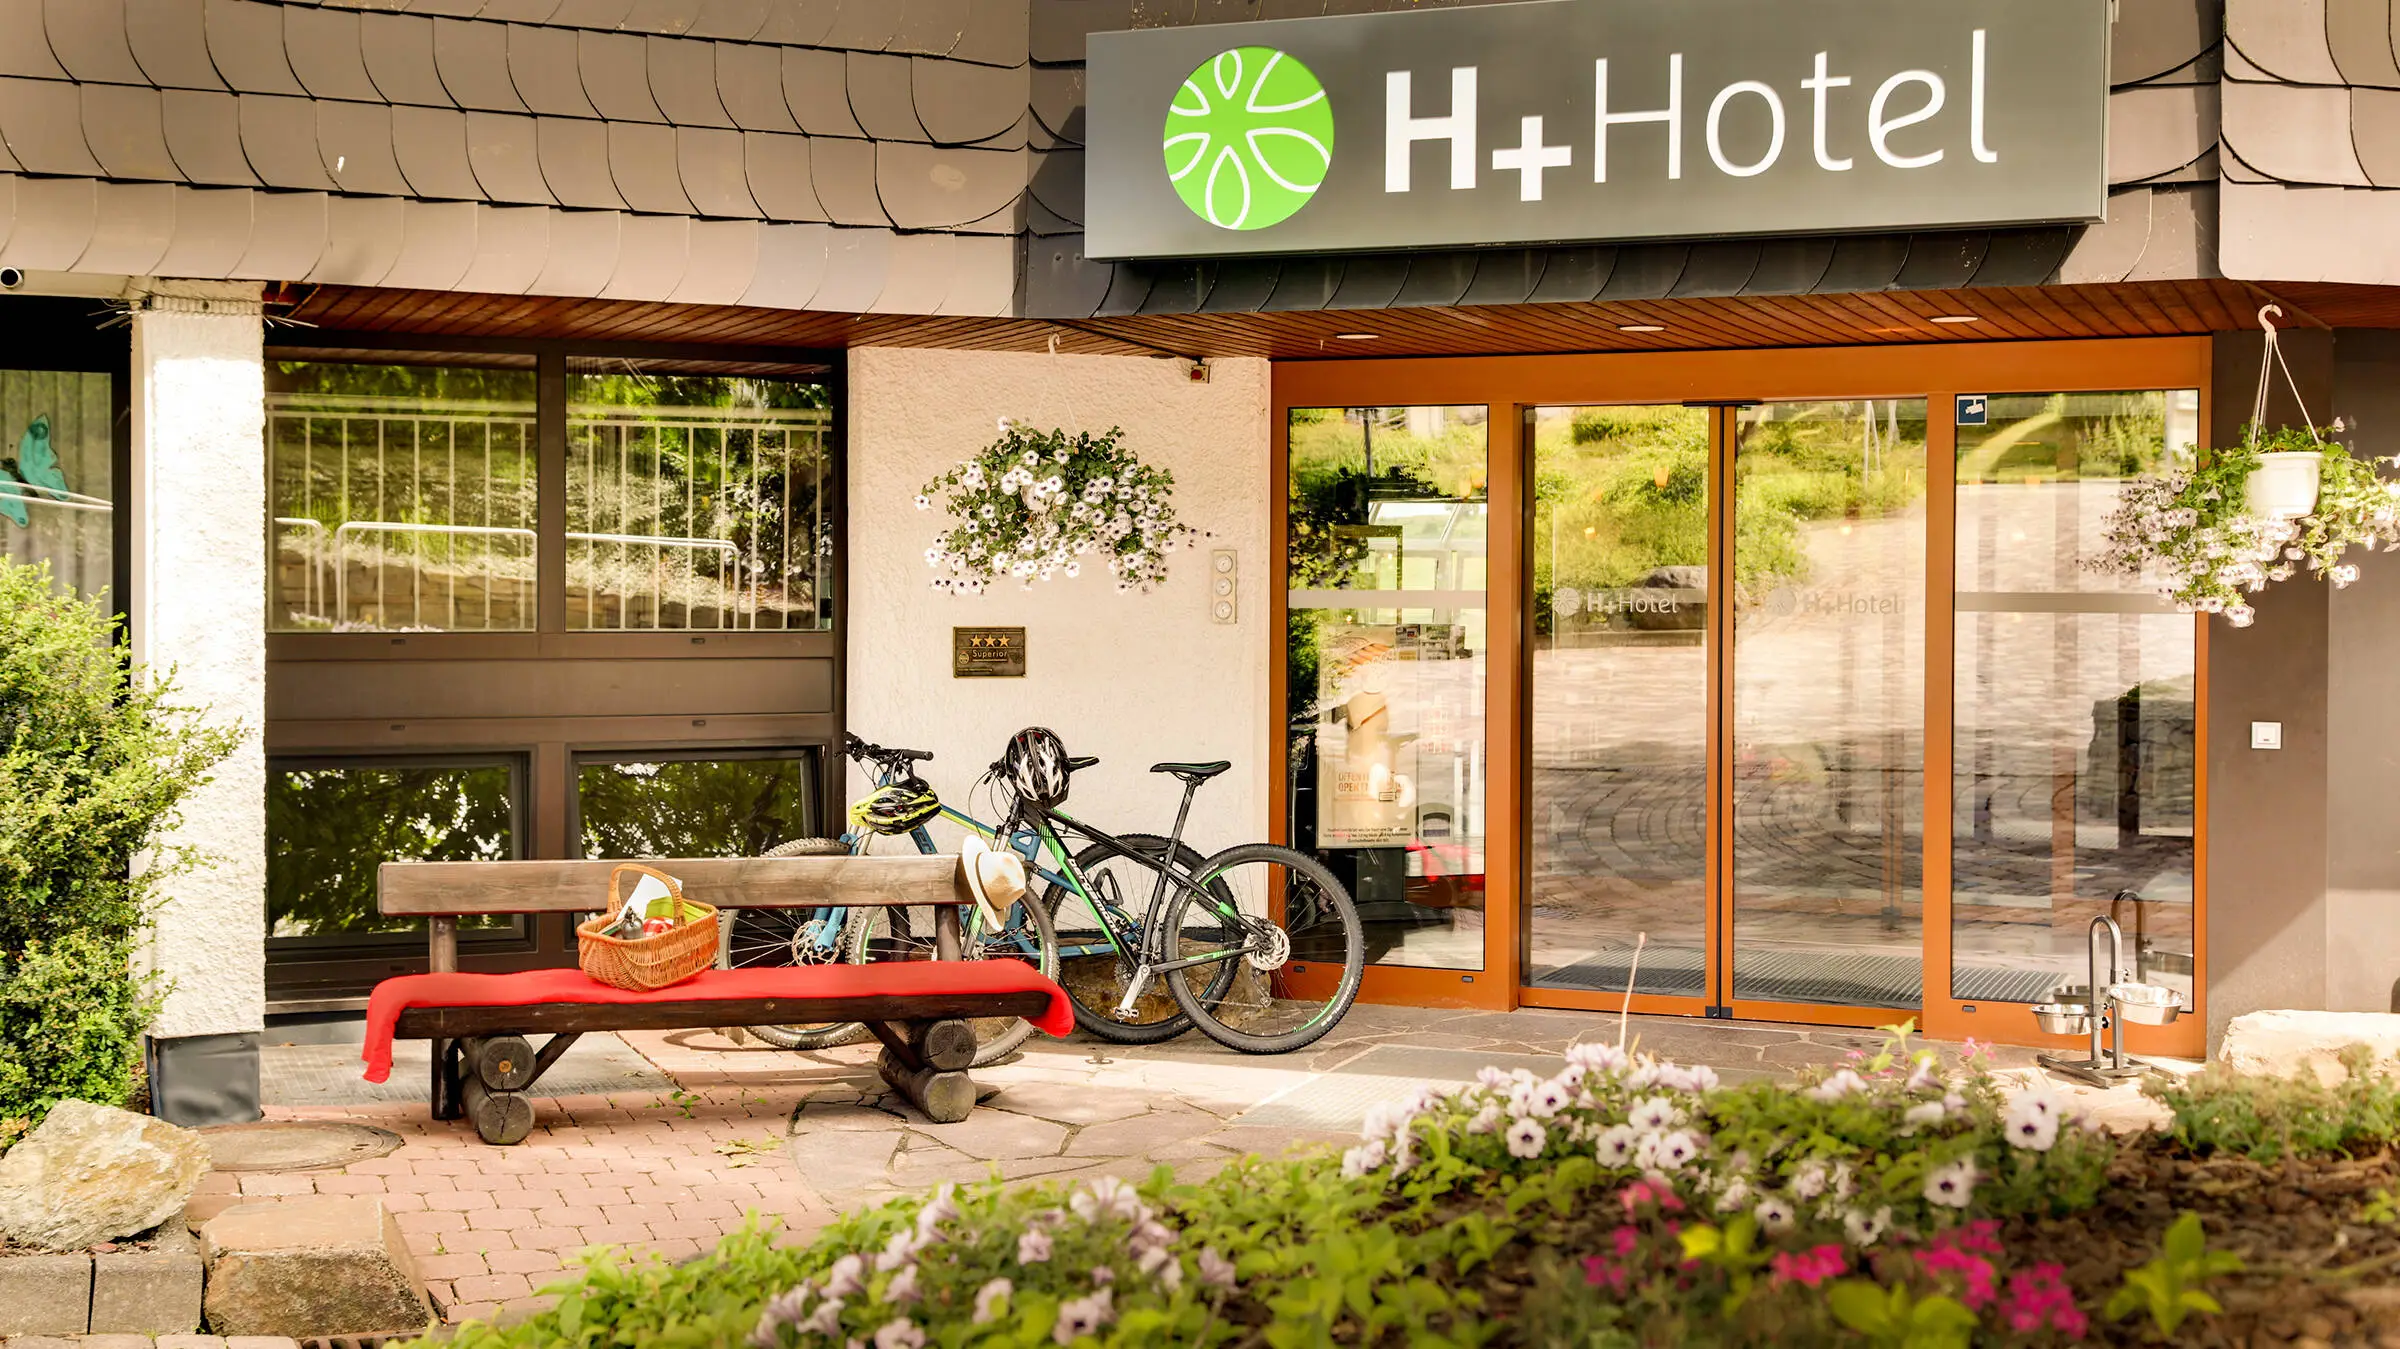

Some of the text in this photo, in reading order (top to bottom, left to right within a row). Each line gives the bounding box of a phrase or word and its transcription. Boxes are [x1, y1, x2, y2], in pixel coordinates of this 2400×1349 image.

[1385, 29, 1998, 201] H+Hotel
[1587, 588, 1678, 614] H+Hotel
[972, 649, 1008, 659] Superior
[1067, 858, 1120, 934] bergamont
